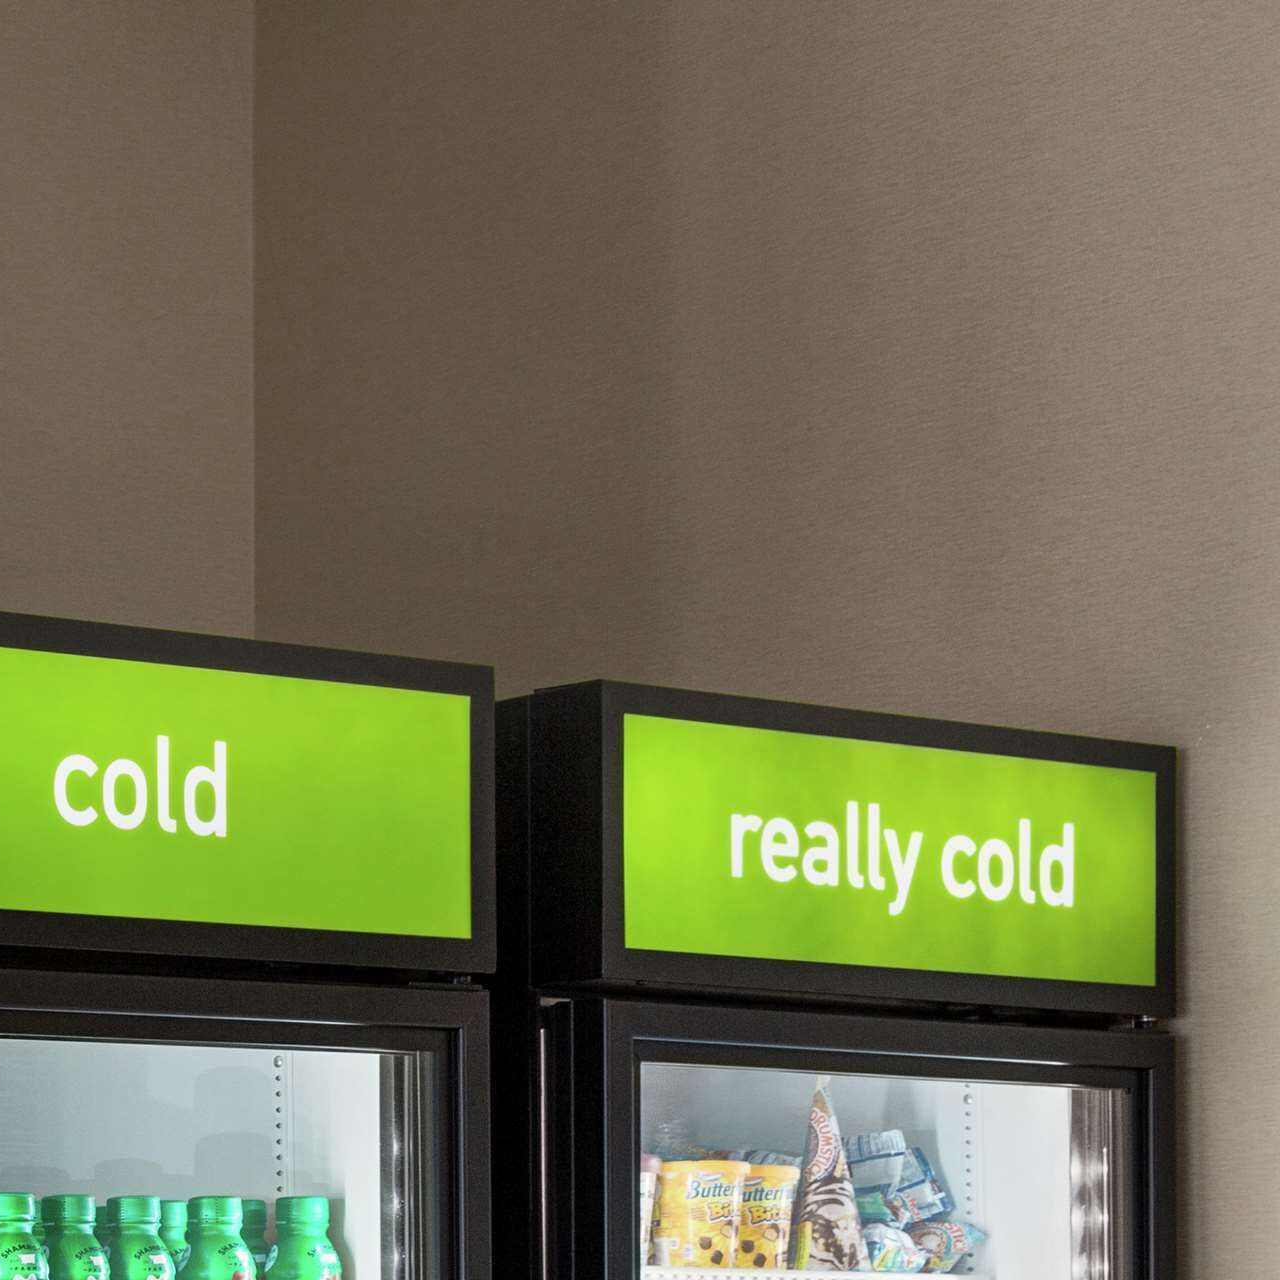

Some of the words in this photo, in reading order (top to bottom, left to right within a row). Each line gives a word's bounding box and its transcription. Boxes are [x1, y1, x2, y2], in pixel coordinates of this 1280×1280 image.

[52, 735, 228, 839] cold
[730, 801, 922, 916] really
[940, 818, 1075, 909] cold
